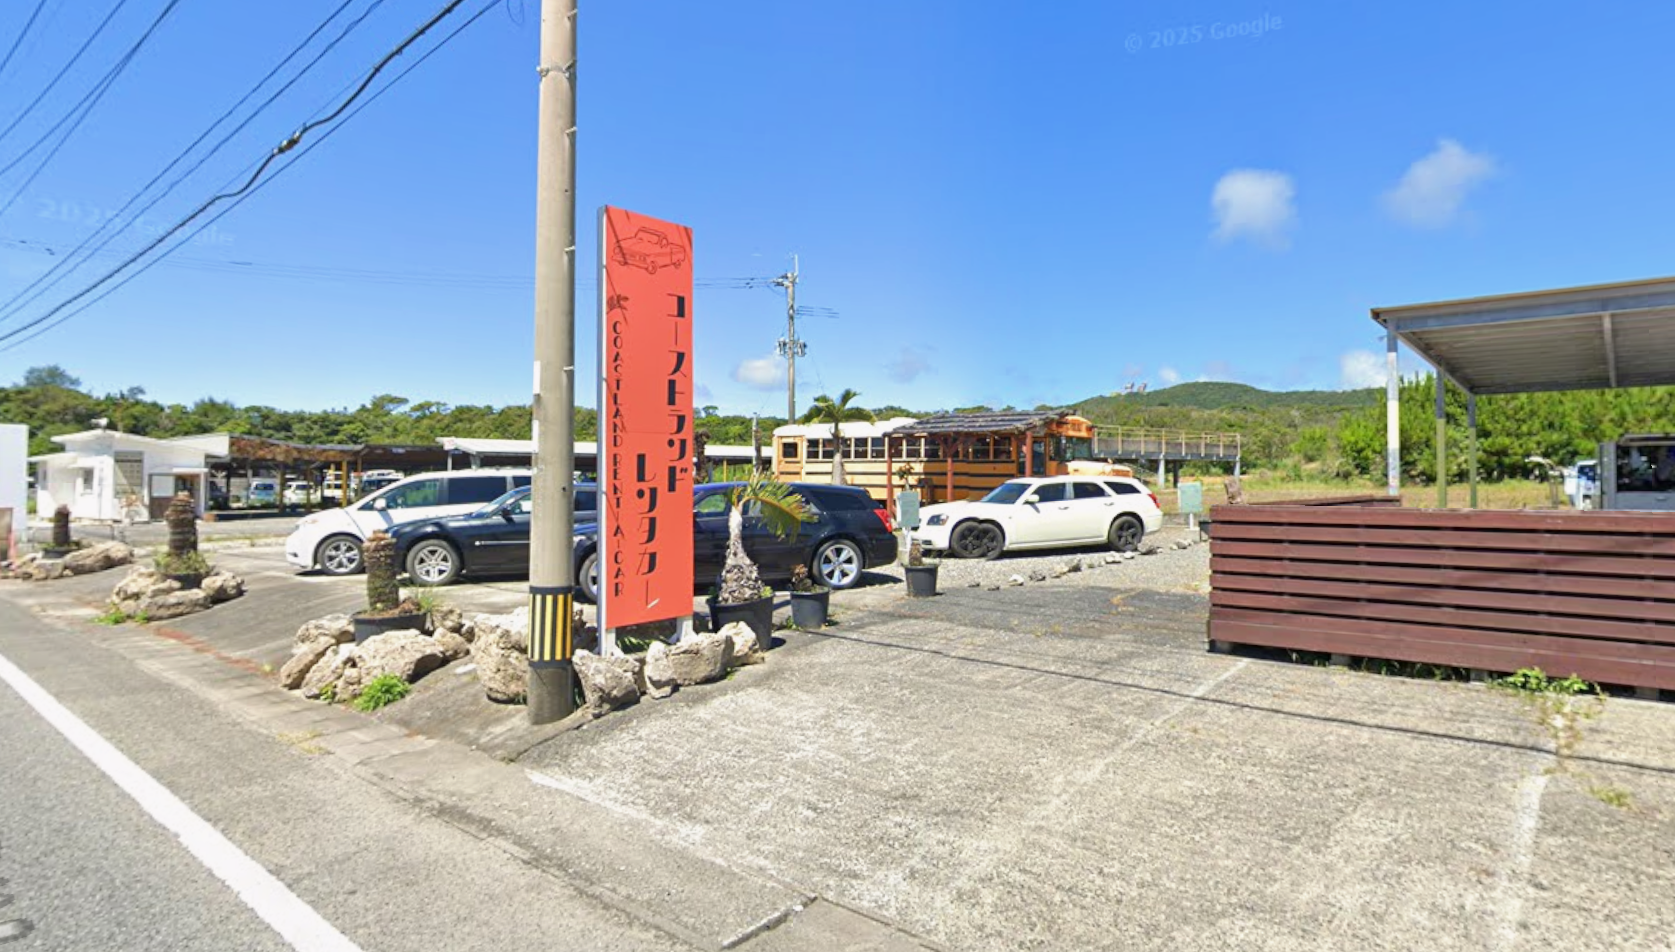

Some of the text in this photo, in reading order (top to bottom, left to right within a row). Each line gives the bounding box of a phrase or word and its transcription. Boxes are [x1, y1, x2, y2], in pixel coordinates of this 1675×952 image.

[667, 293, 688, 493] コーストランド
[636, 453, 658, 606] レンタカー
